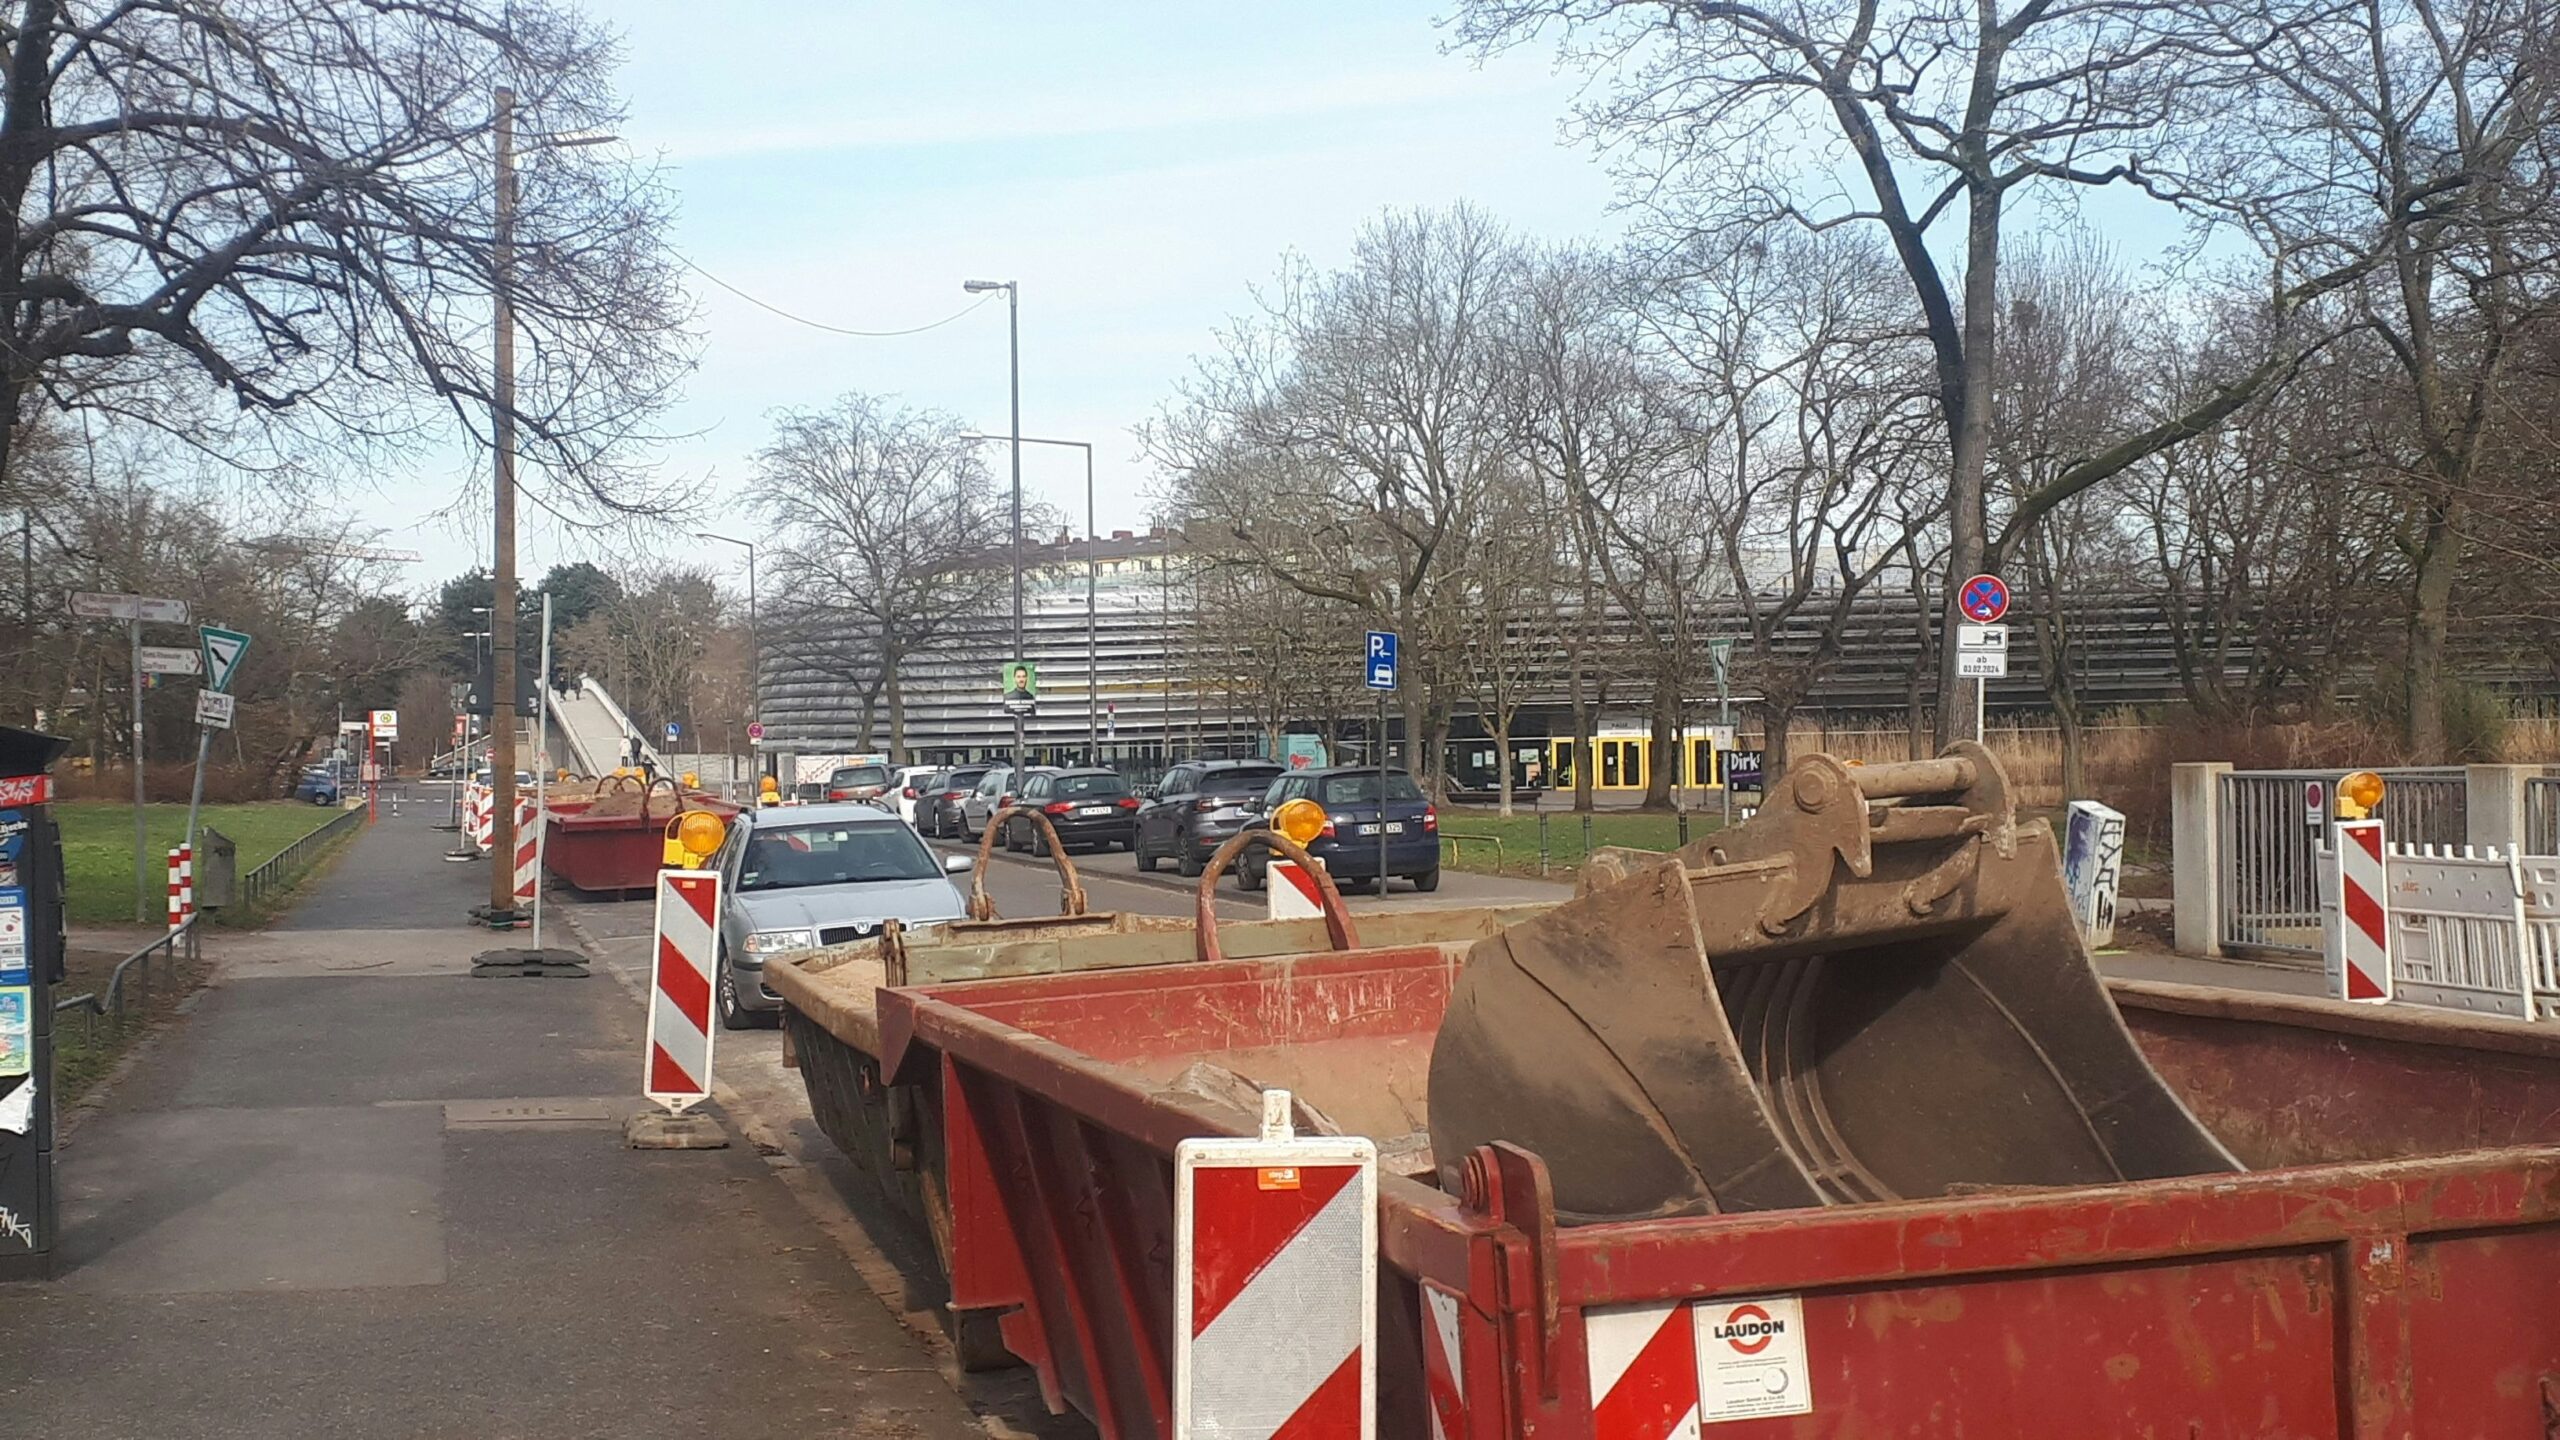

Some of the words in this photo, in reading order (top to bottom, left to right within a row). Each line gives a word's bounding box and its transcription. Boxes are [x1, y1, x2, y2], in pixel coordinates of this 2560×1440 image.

[1371, 635, 1384, 658] P
[1730, 752, 1761, 771] Dirks
[1714, 1320, 1785, 1339] LAUDON
